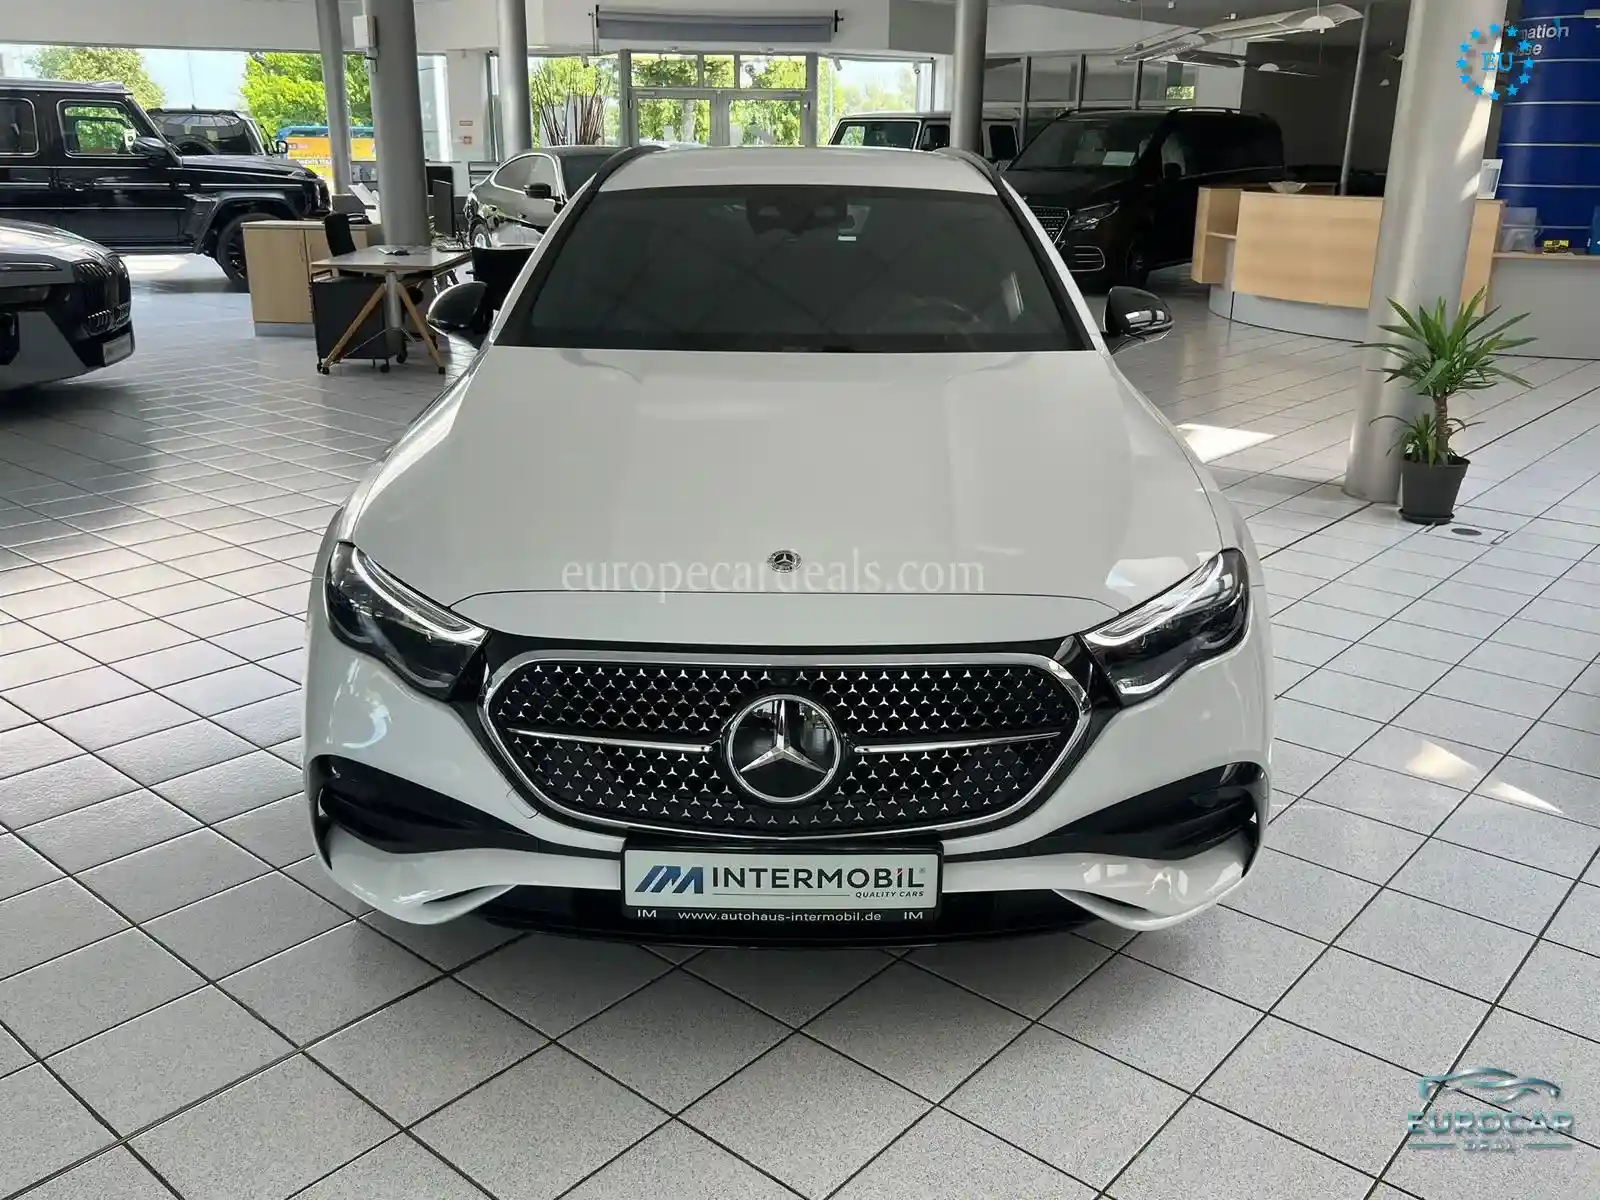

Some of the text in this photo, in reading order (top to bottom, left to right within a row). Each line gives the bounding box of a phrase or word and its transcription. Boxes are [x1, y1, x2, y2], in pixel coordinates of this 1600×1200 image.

[855, 890, 924, 899] QUALITY CARS
[637, 909, 924, 922] IM www.autohaus-intermobil.de IM
